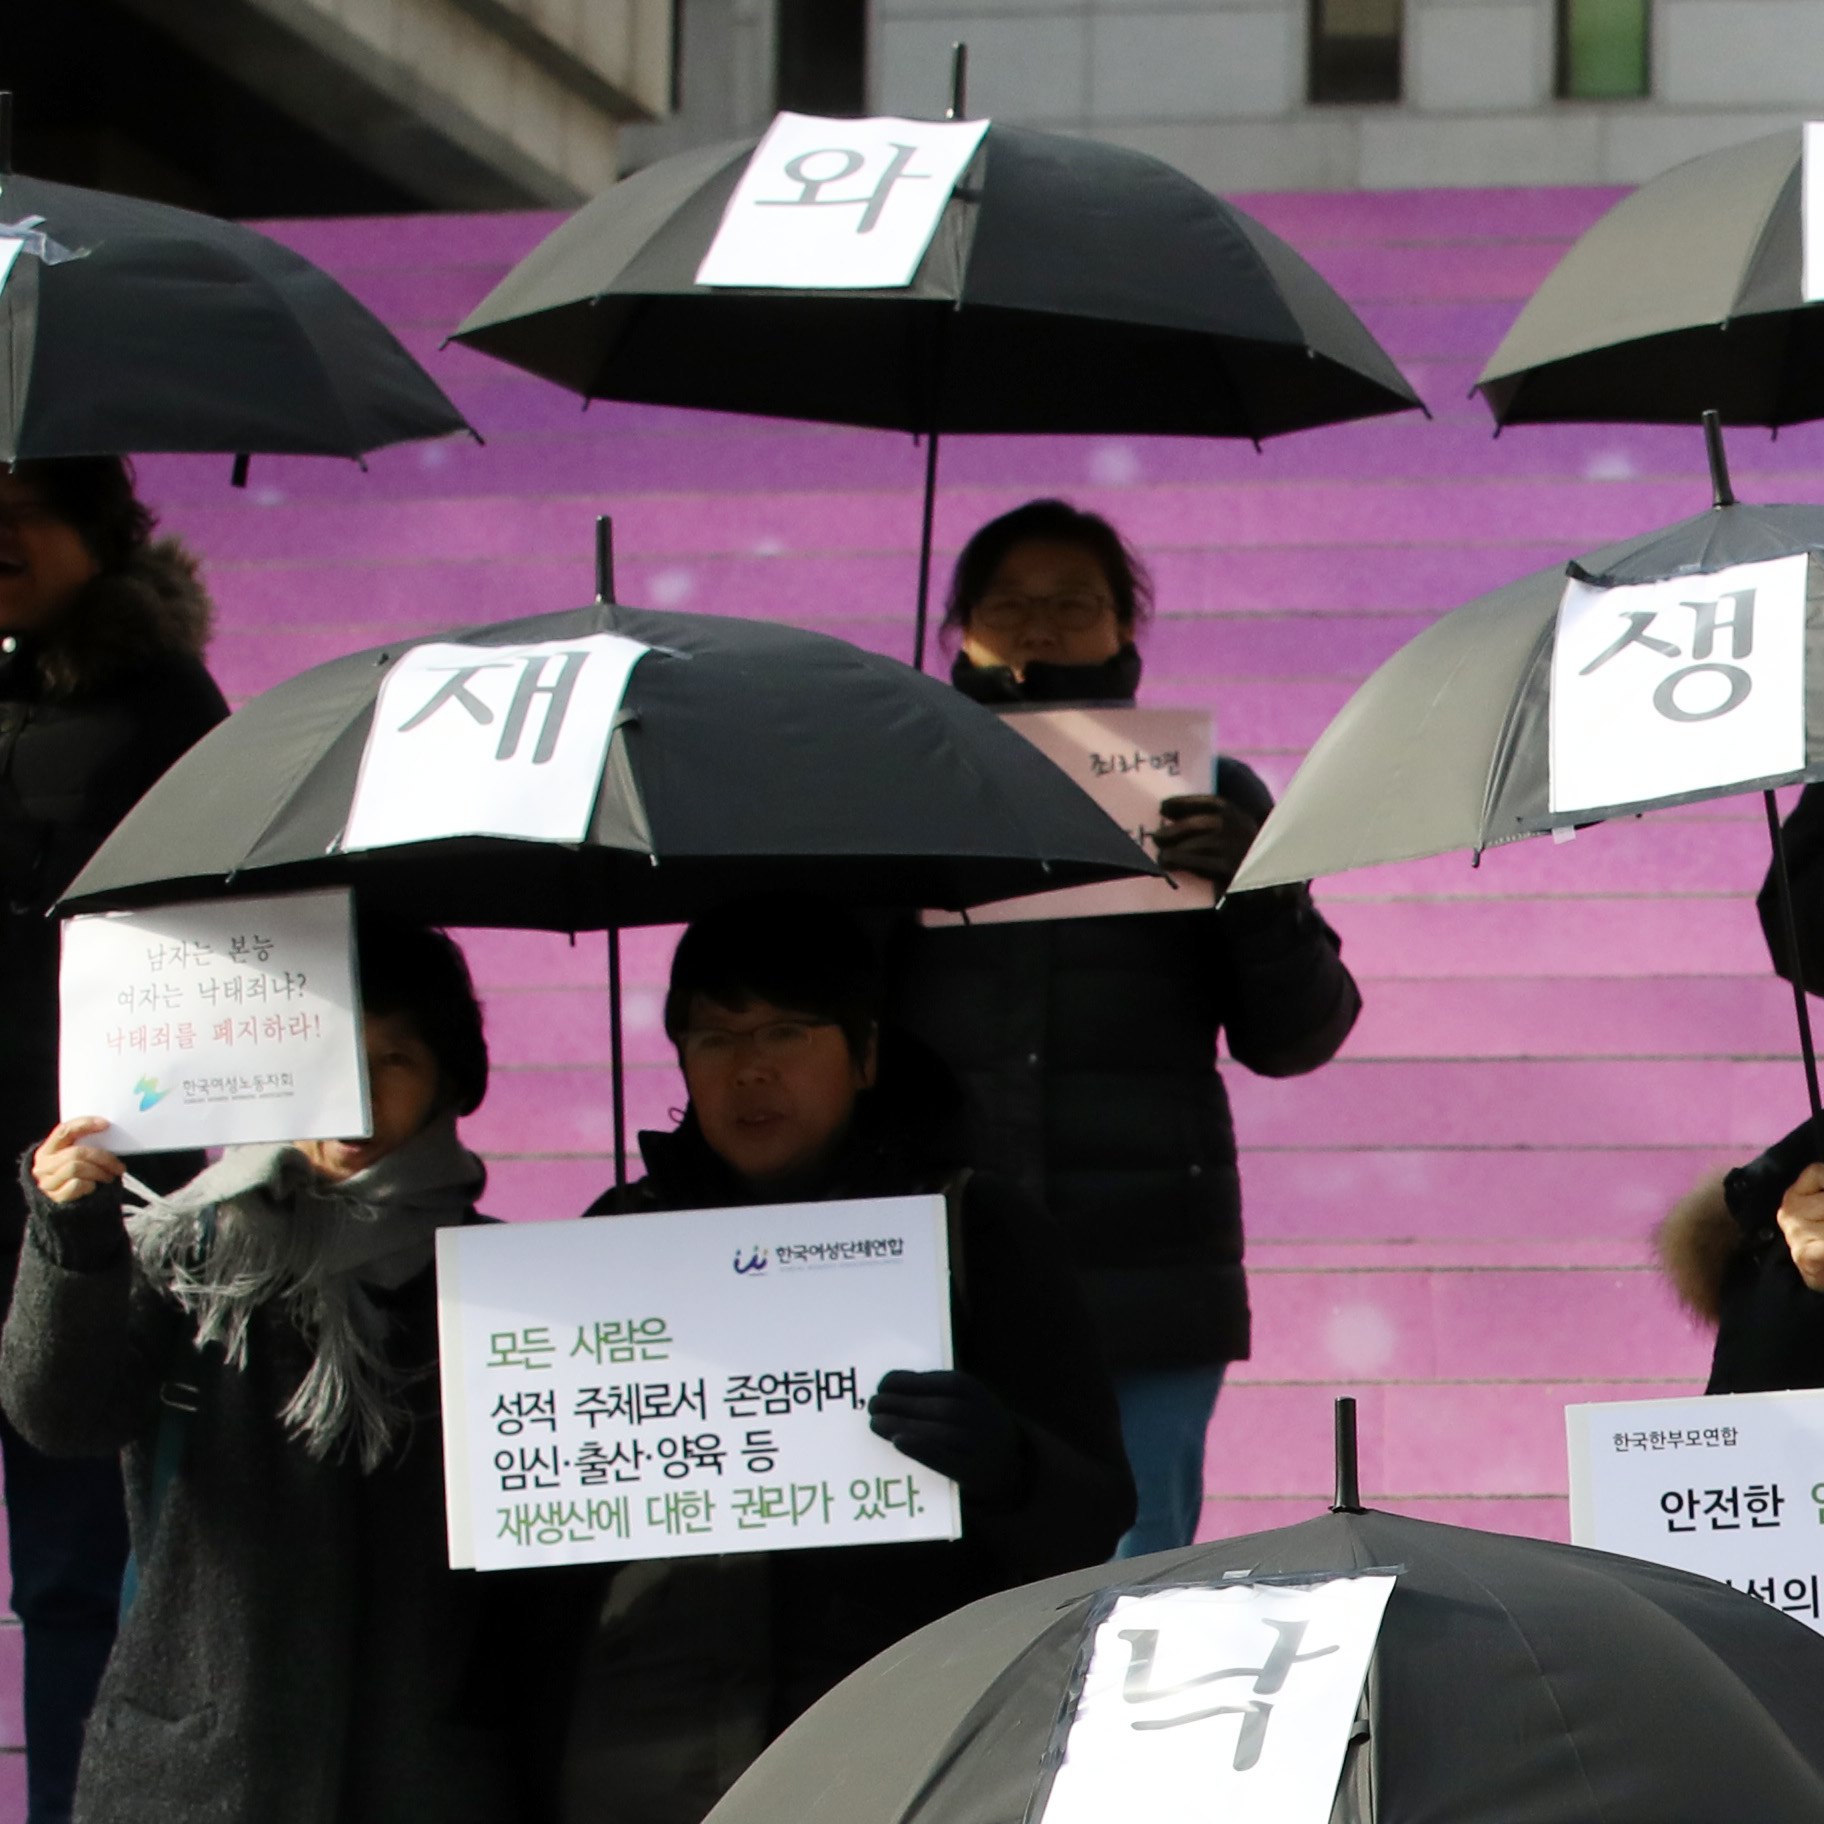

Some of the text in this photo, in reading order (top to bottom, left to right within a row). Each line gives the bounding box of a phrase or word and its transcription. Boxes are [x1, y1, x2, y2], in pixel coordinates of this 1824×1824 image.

[754, 143, 931, 234] 와
[1580, 591, 1755, 722] 생
[398, 651, 590, 764] 재
[148, 935, 274, 971] 남자는 본능
[118, 973, 306, 1013] 여자는 낙태죄냐?
[106, 1013, 321, 1052] 낙태죄를 폐지하라!
[775, 1238, 903, 1264] 한국여성단체연합
[486, 1317, 673, 1369] 모든 사람은
[491, 1367, 866, 1436] 성적 주체로서 존엄하며,
[741, 1429, 779, 1474] 등
[1612, 1427, 1738, 1452] 한국한부모연합
[497, 1474, 924, 1546] 재생산에 대한 권리가 있다.
[1660, 1484, 1784, 1533] 안전한
[1117, 1618, 1340, 1771] 낙
